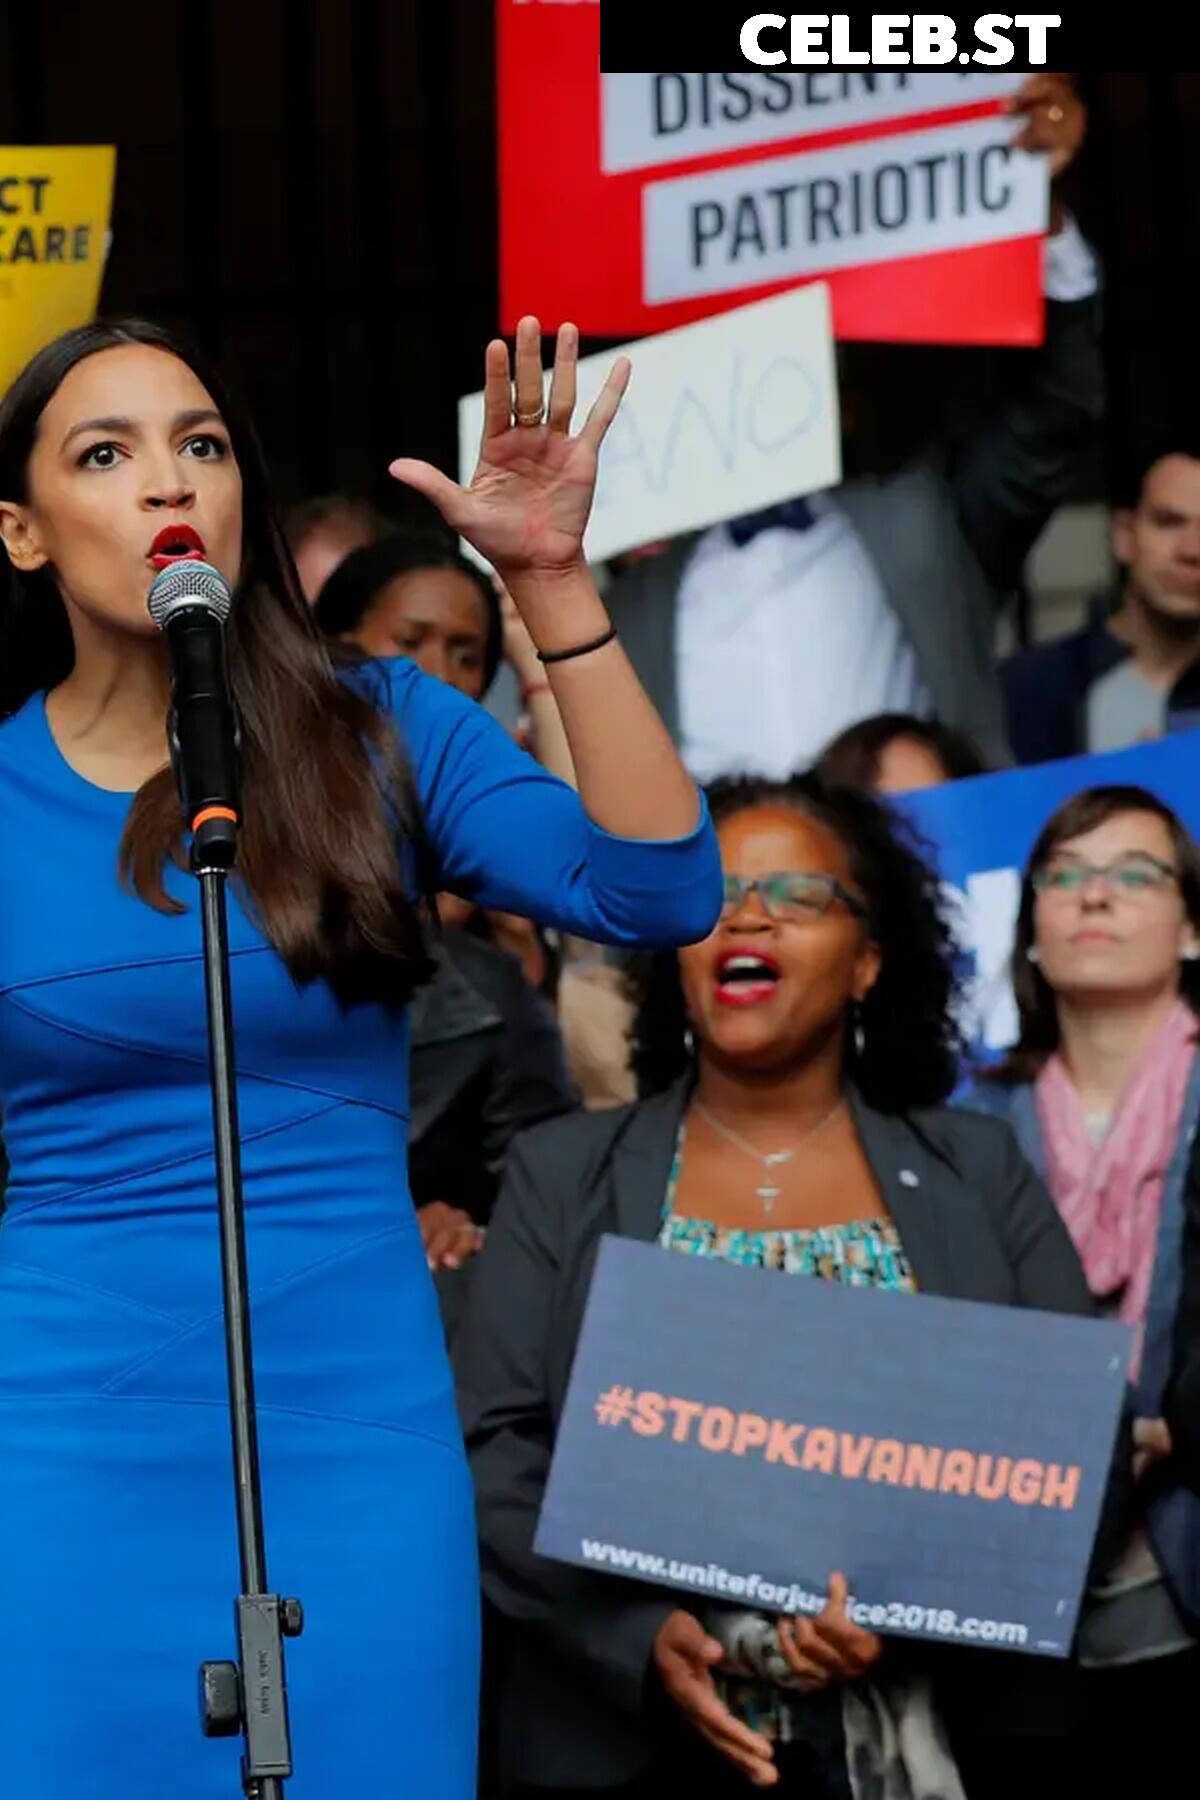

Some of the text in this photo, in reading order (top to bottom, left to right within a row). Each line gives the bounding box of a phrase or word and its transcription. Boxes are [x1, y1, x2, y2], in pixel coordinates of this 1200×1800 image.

[652, 73, 906, 137] DISSE
[690, 143, 1014, 269] PATRIOTIC
[594, 1384, 1083, 1511] #STOPKAVANAUGH
[580, 1538, 1029, 1645] www.uniteforjuice2018.com
